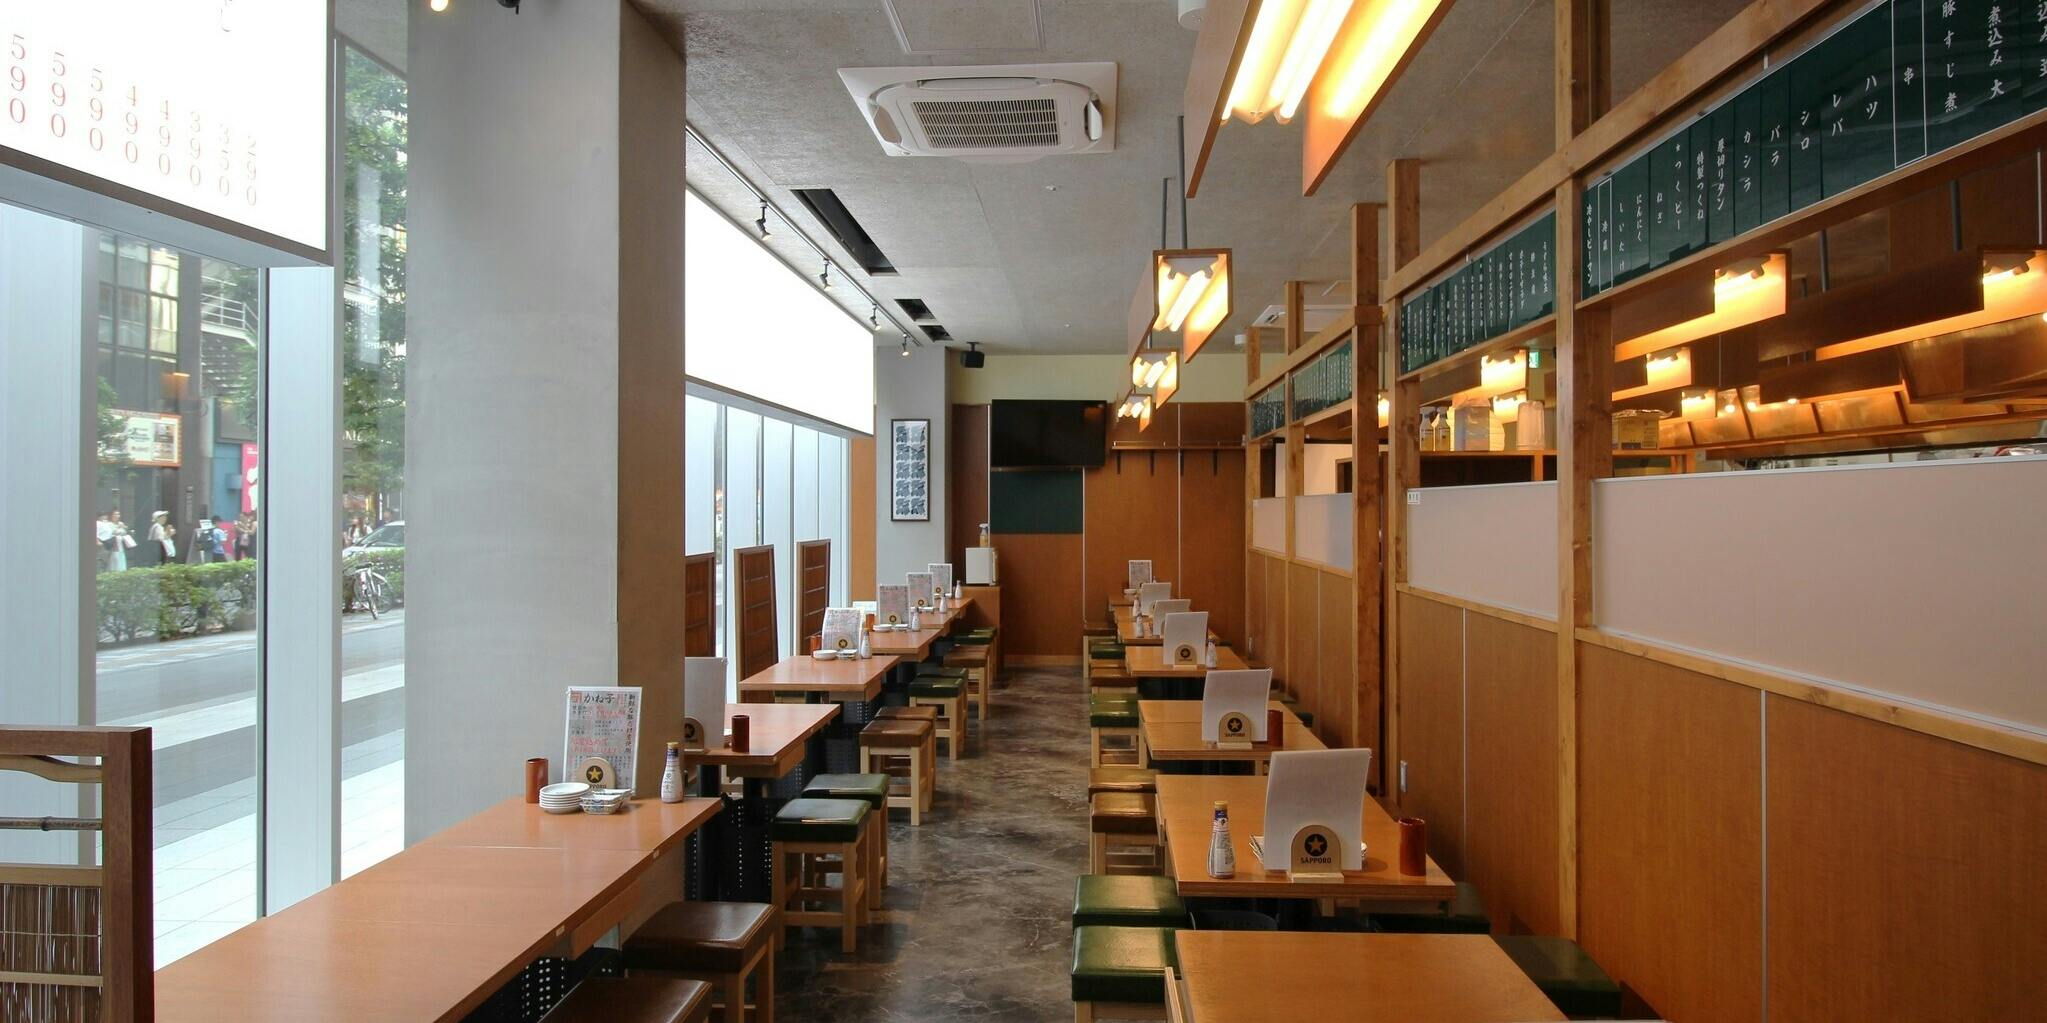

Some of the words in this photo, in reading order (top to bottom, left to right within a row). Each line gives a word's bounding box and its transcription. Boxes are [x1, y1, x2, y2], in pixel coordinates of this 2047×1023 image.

[10, 34, 25, 123] 590
[1903, 67, 1914, 86] 串
[1942, 0, 1958, 113] 豚すじ煮
[51, 52, 66, 137] 590
[89, 68, 103, 151] 590
[125, 86, 138, 163] 490
[1831, 94, 1843, 137] レバ
[1865, 75, 1878, 119] ハツ
[159, 100, 171, 175] 490
[1743, 130, 1752, 193] カシラ
[1770, 124, 1781, 166] バラ
[1800, 110, 1810, 150] シロ
[1696, 151, 1704, 220] 特製つくね
[1716, 137, 1725, 211] 厚切りタン
[1656, 192, 1663, 224] ねぎ
[583, 693, 616, 704] かね子
[1300, 857, 1332, 865] SAPPORO
